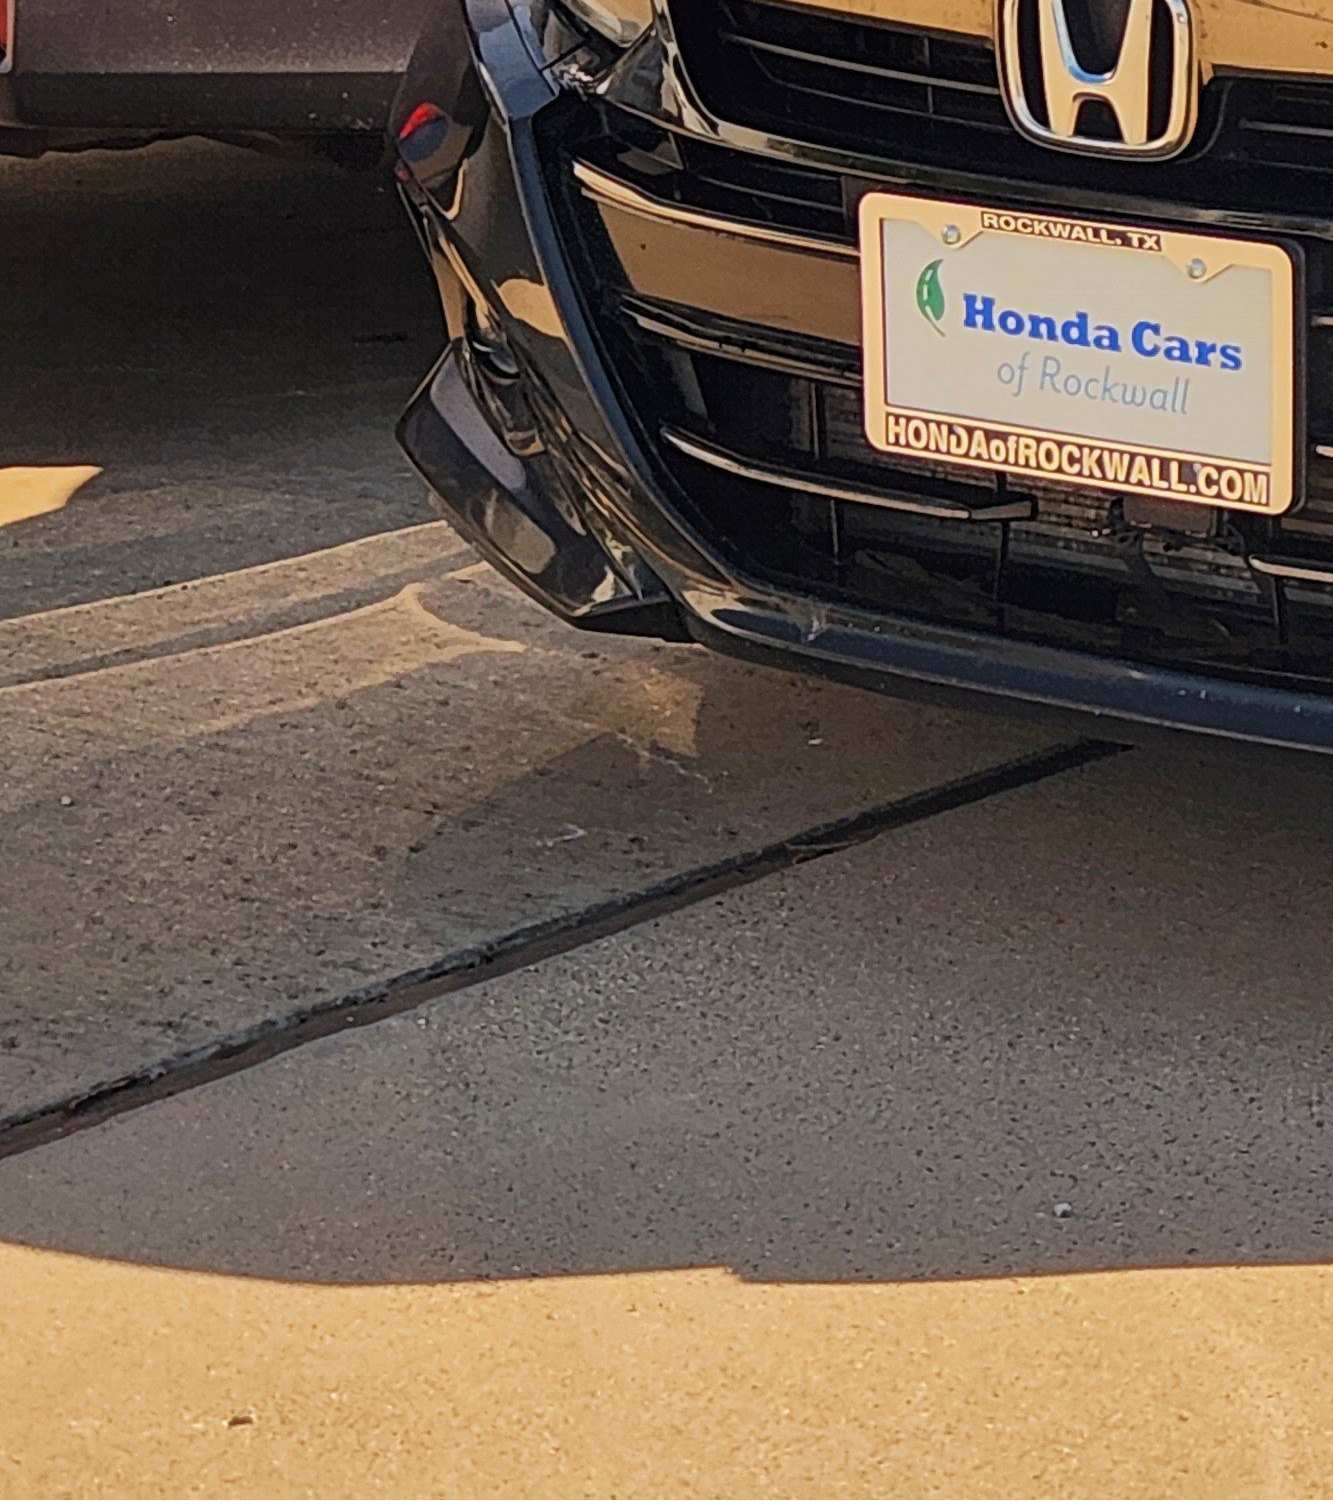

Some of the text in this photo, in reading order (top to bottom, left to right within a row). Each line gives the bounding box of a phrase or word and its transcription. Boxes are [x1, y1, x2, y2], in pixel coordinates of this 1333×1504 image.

[1127, 231, 1161, 251] TX
[963, 293, 1243, 371] Honda Cars
[997, 351, 1190, 415] of Rockwall
[887, 414, 1269, 505] HONDAofROCKWALL.COM
